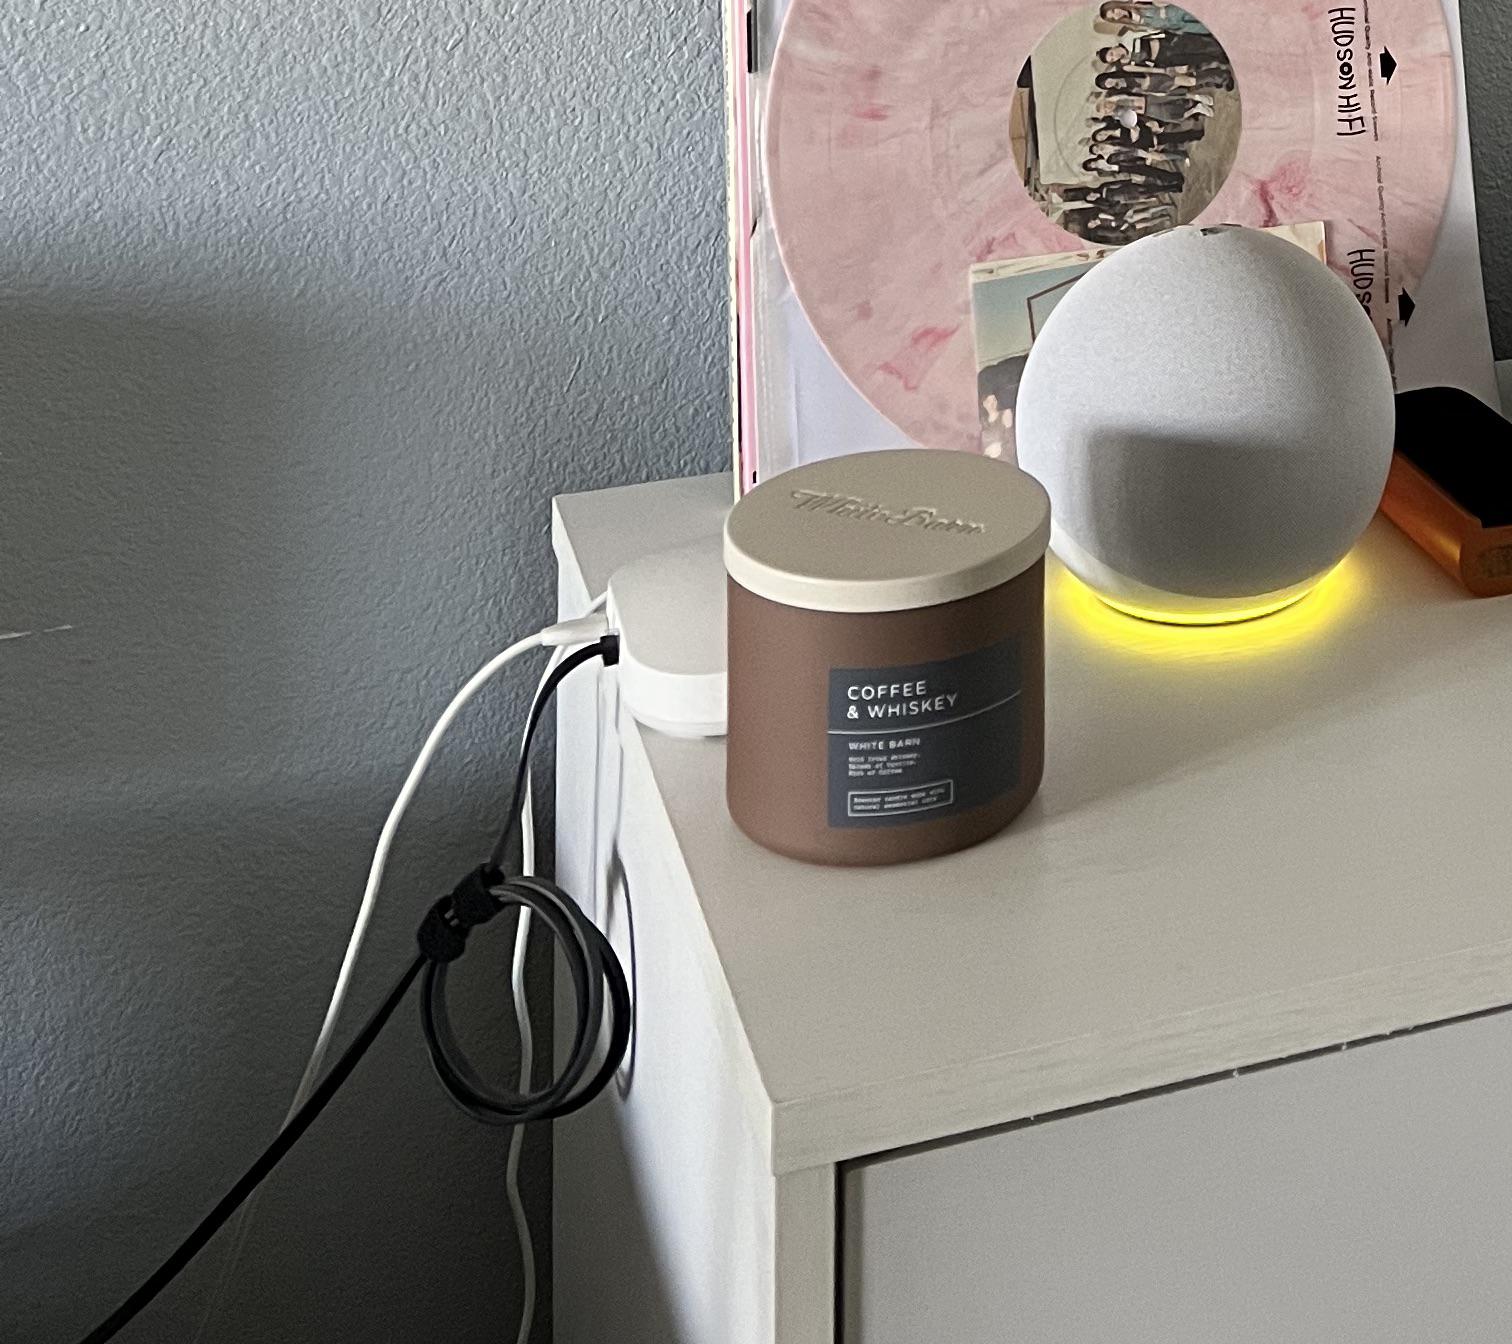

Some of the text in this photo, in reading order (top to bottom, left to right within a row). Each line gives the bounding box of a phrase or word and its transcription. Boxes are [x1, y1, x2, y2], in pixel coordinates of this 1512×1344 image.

[1327, 7, 1356, 90] HUDSON
[1347, 249, 1376, 315] HUDS
[847, 680, 927, 701] COFFEE
[846, 693, 957, 719] & WHISKEY
[848, 738, 920, 750] WHITE BARN
